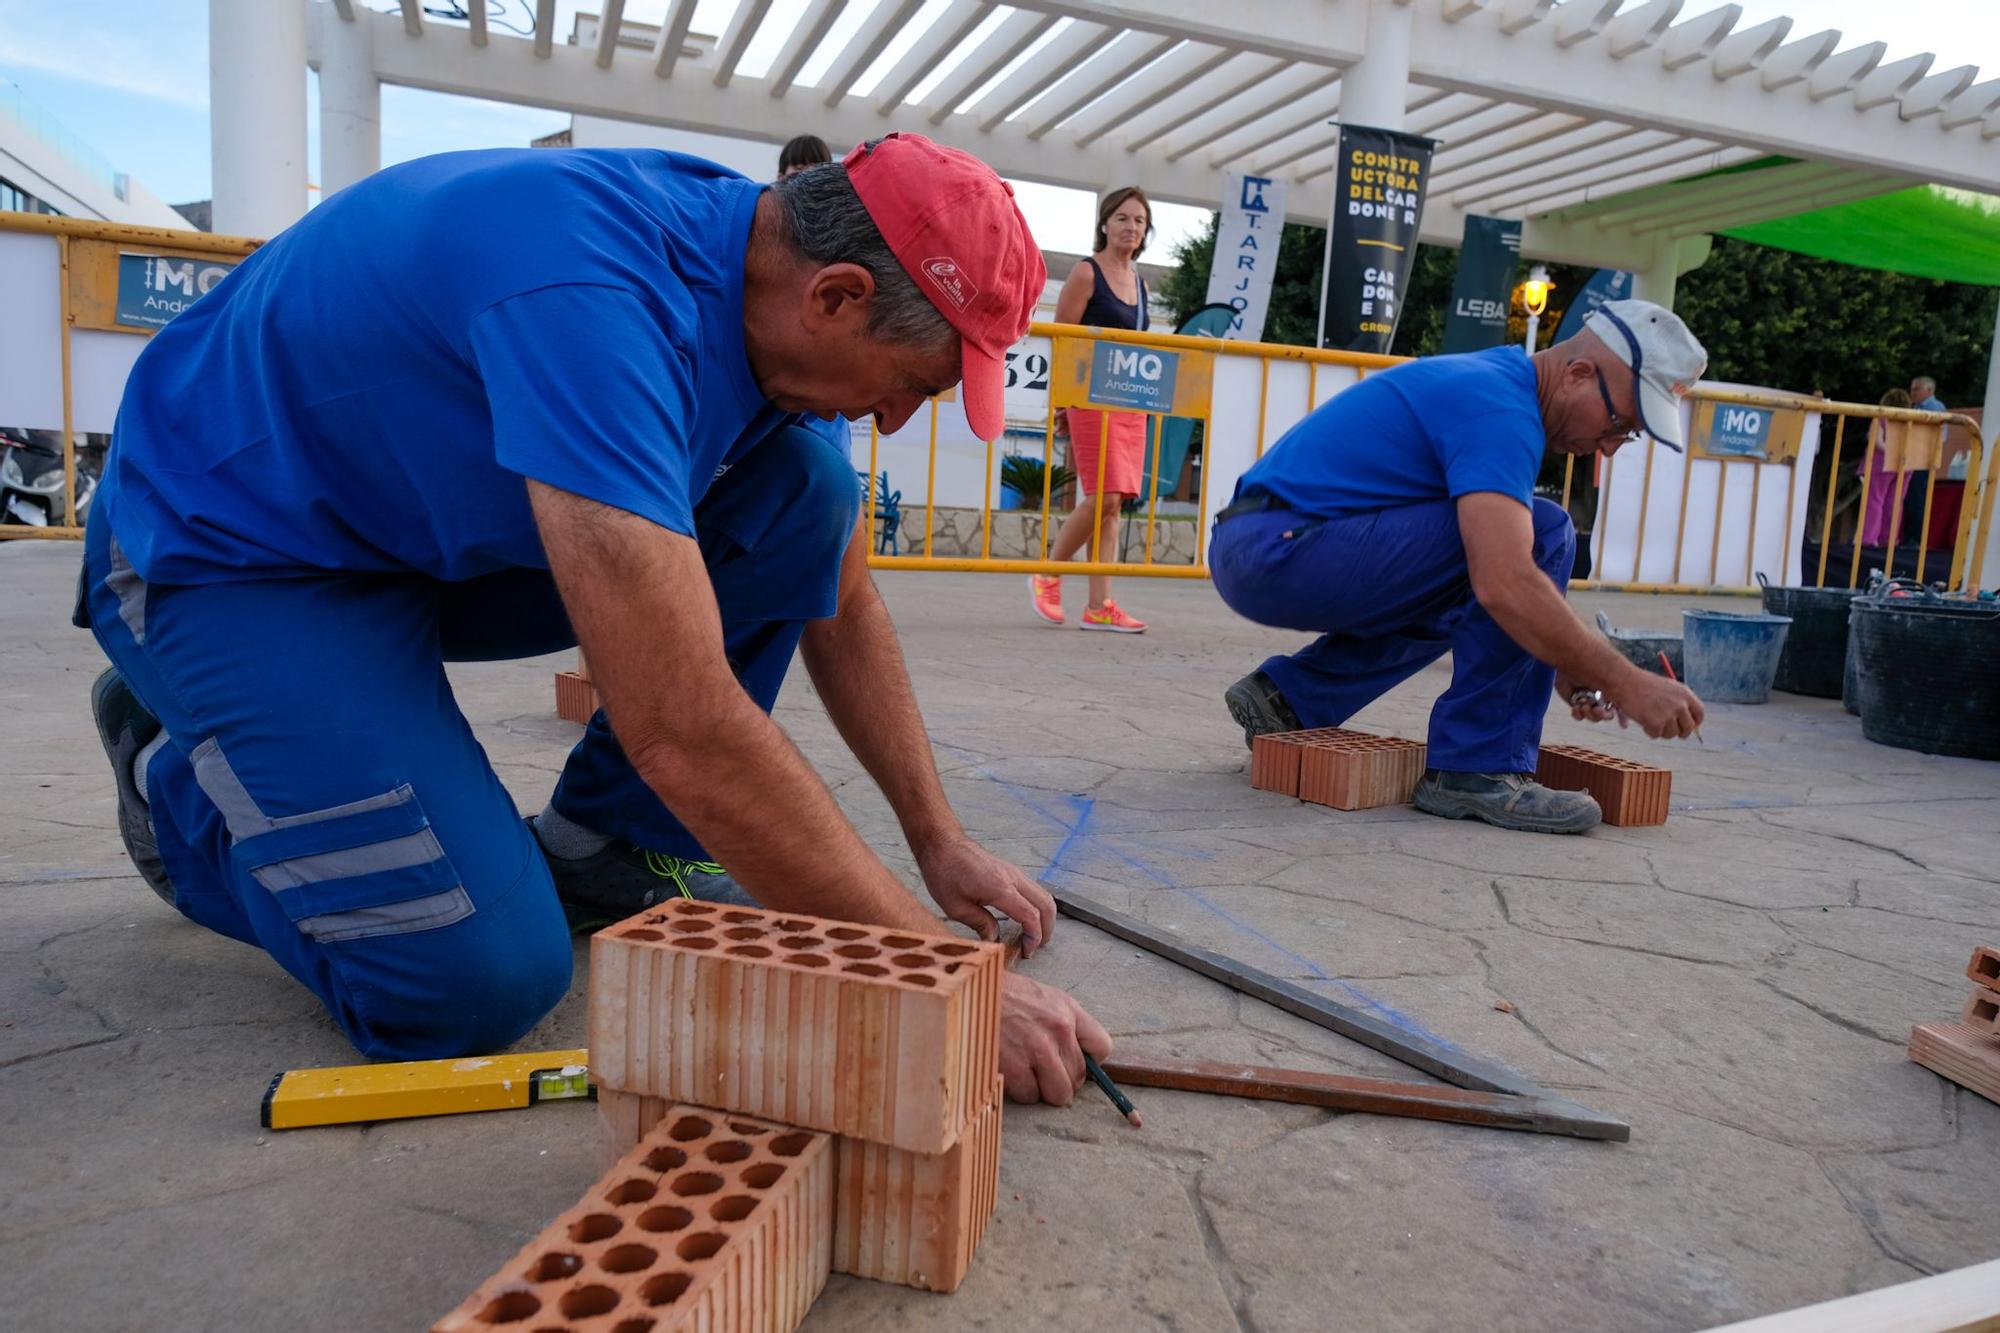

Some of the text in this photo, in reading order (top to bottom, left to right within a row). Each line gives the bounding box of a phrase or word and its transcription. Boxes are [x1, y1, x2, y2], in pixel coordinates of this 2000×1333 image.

[1352, 150, 1419, 175] CONSTR
[1351, 167, 1418, 192] UCTORA
[1364, 268, 1394, 286] CAR
[1363, 285, 1394, 302] DON
[1113, 349, 1163, 381] MQ
[1105, 379, 1159, 396] Andamios
[1726, 409, 1760, 434] MQ
